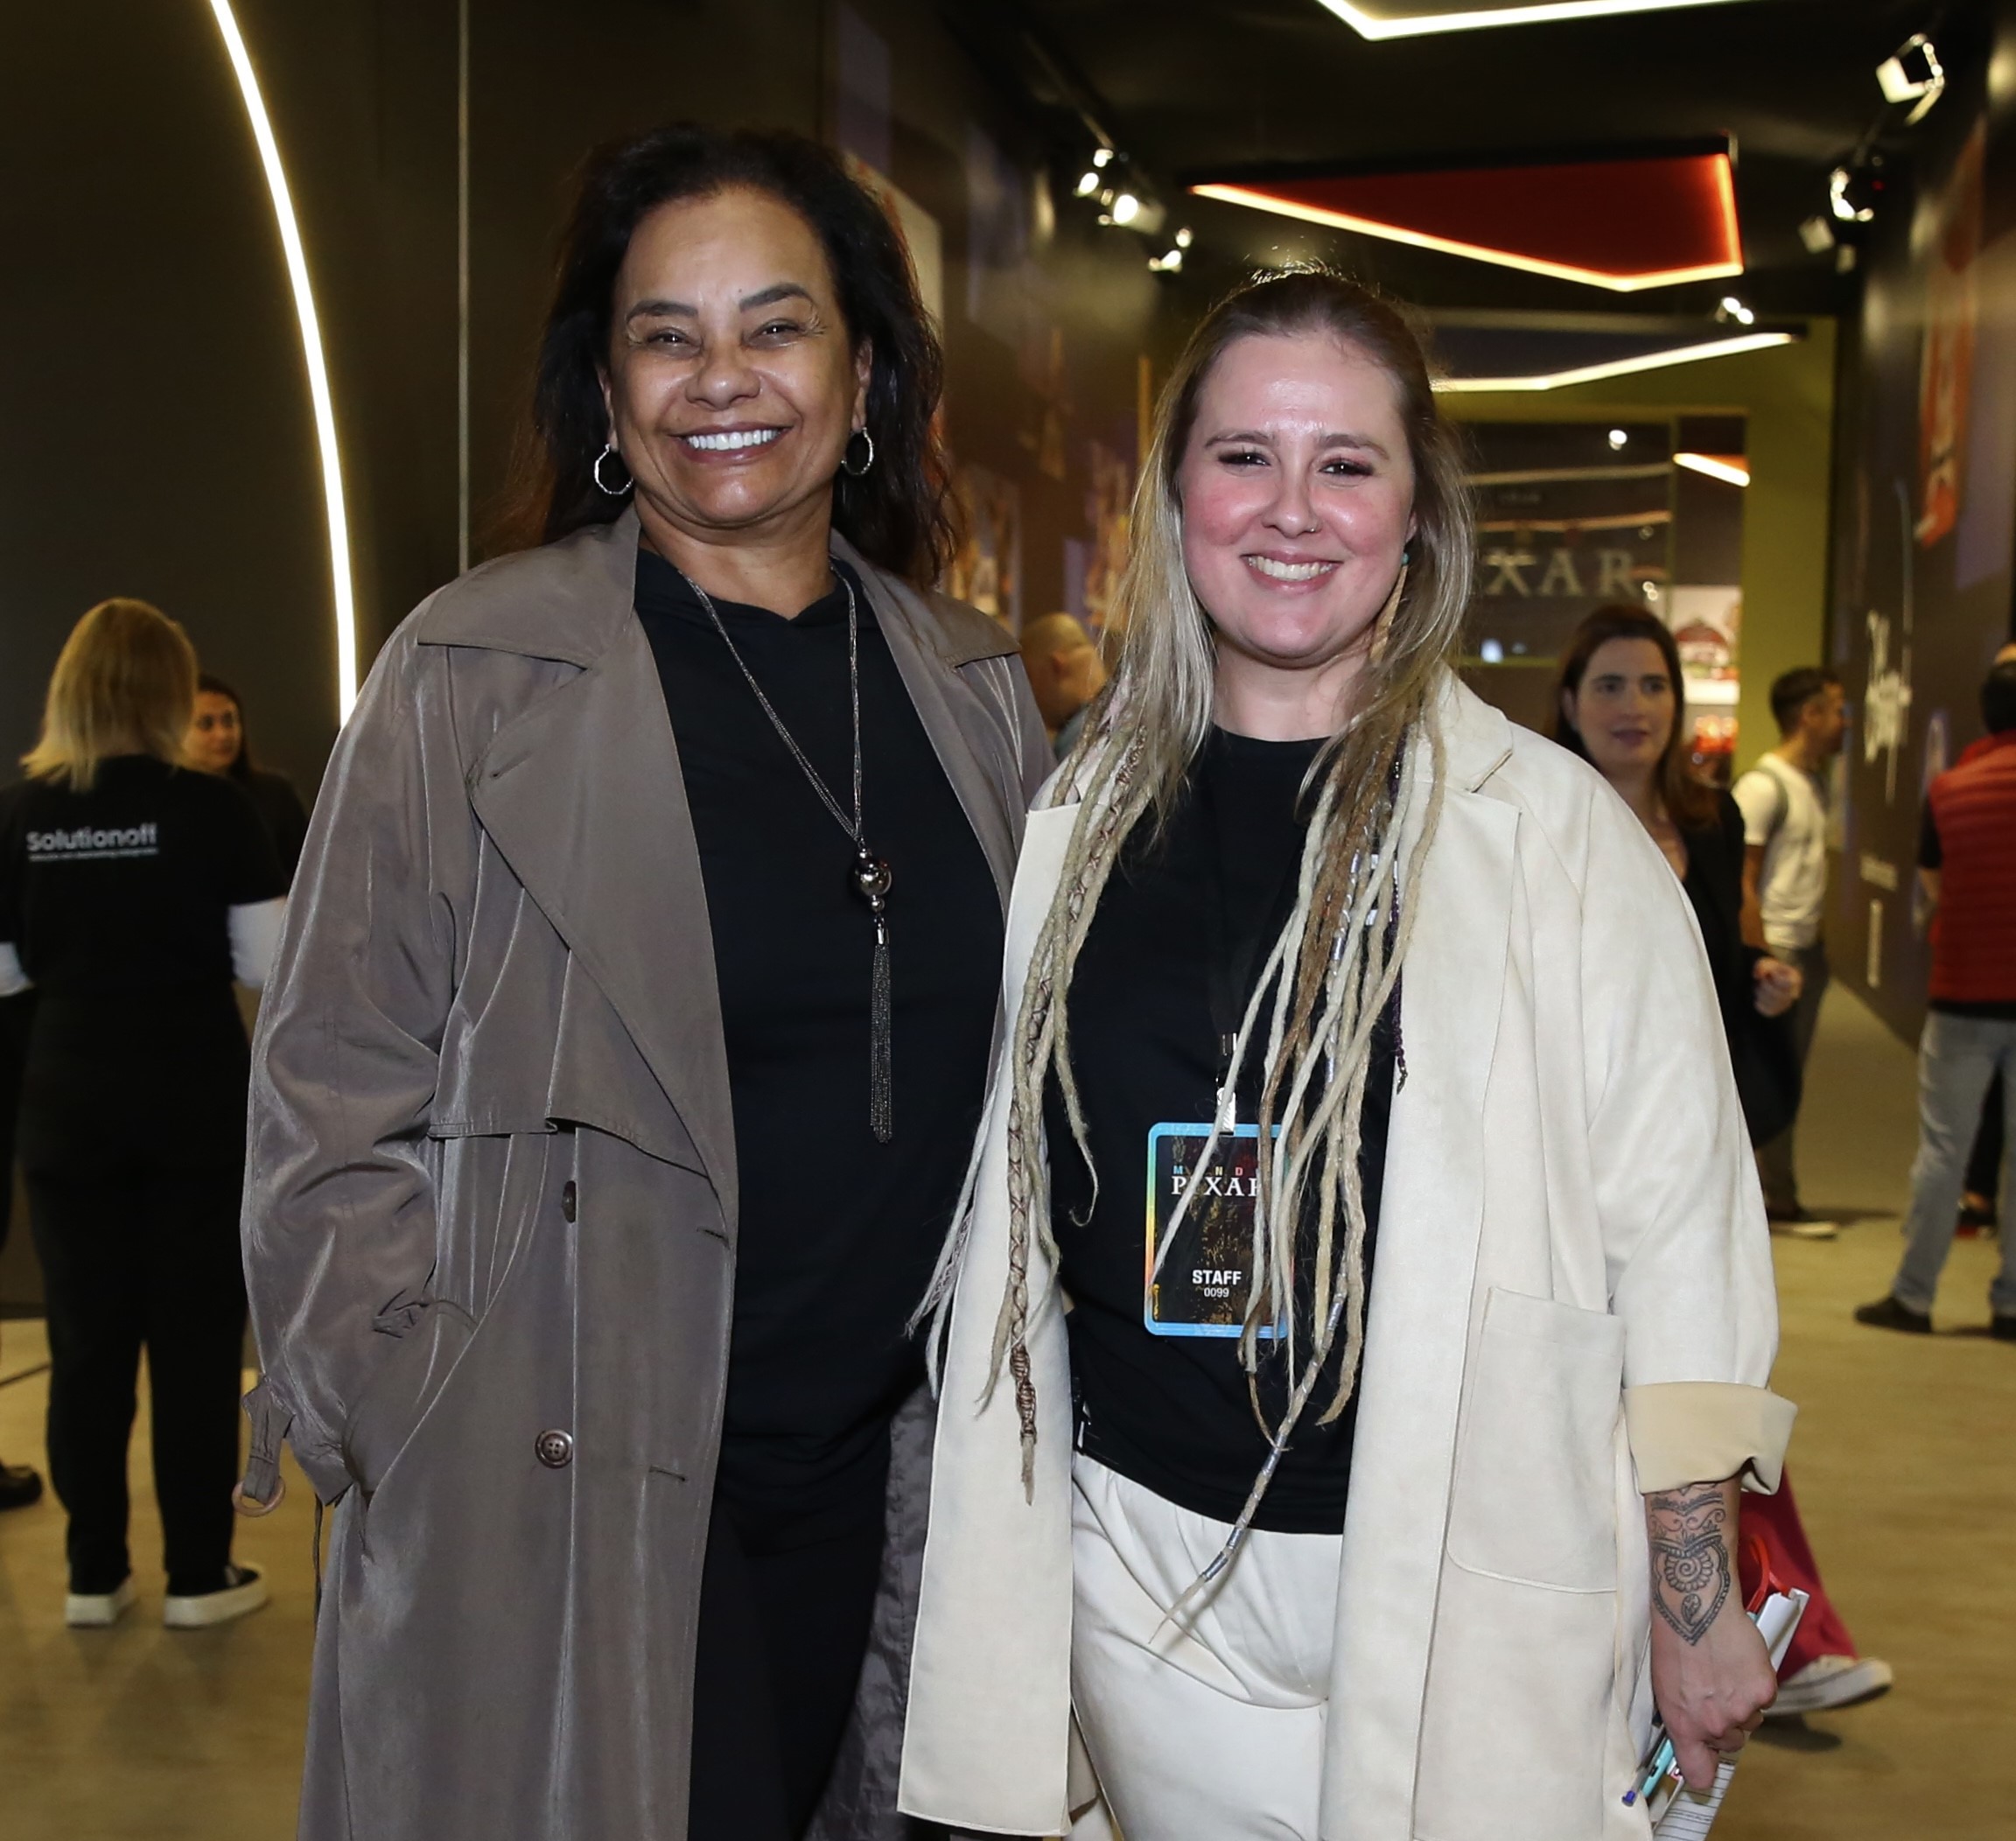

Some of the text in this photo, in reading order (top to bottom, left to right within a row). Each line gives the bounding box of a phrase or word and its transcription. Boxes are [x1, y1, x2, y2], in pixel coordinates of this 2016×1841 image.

[1485, 547, 1640, 597] XAR
[1173, 1166, 1257, 1176] MND
[1172, 1175, 1258, 1196] PXA
[1192, 1270, 1242, 1284] STAFF
[1204, 1287, 1229, 1298] 0099
